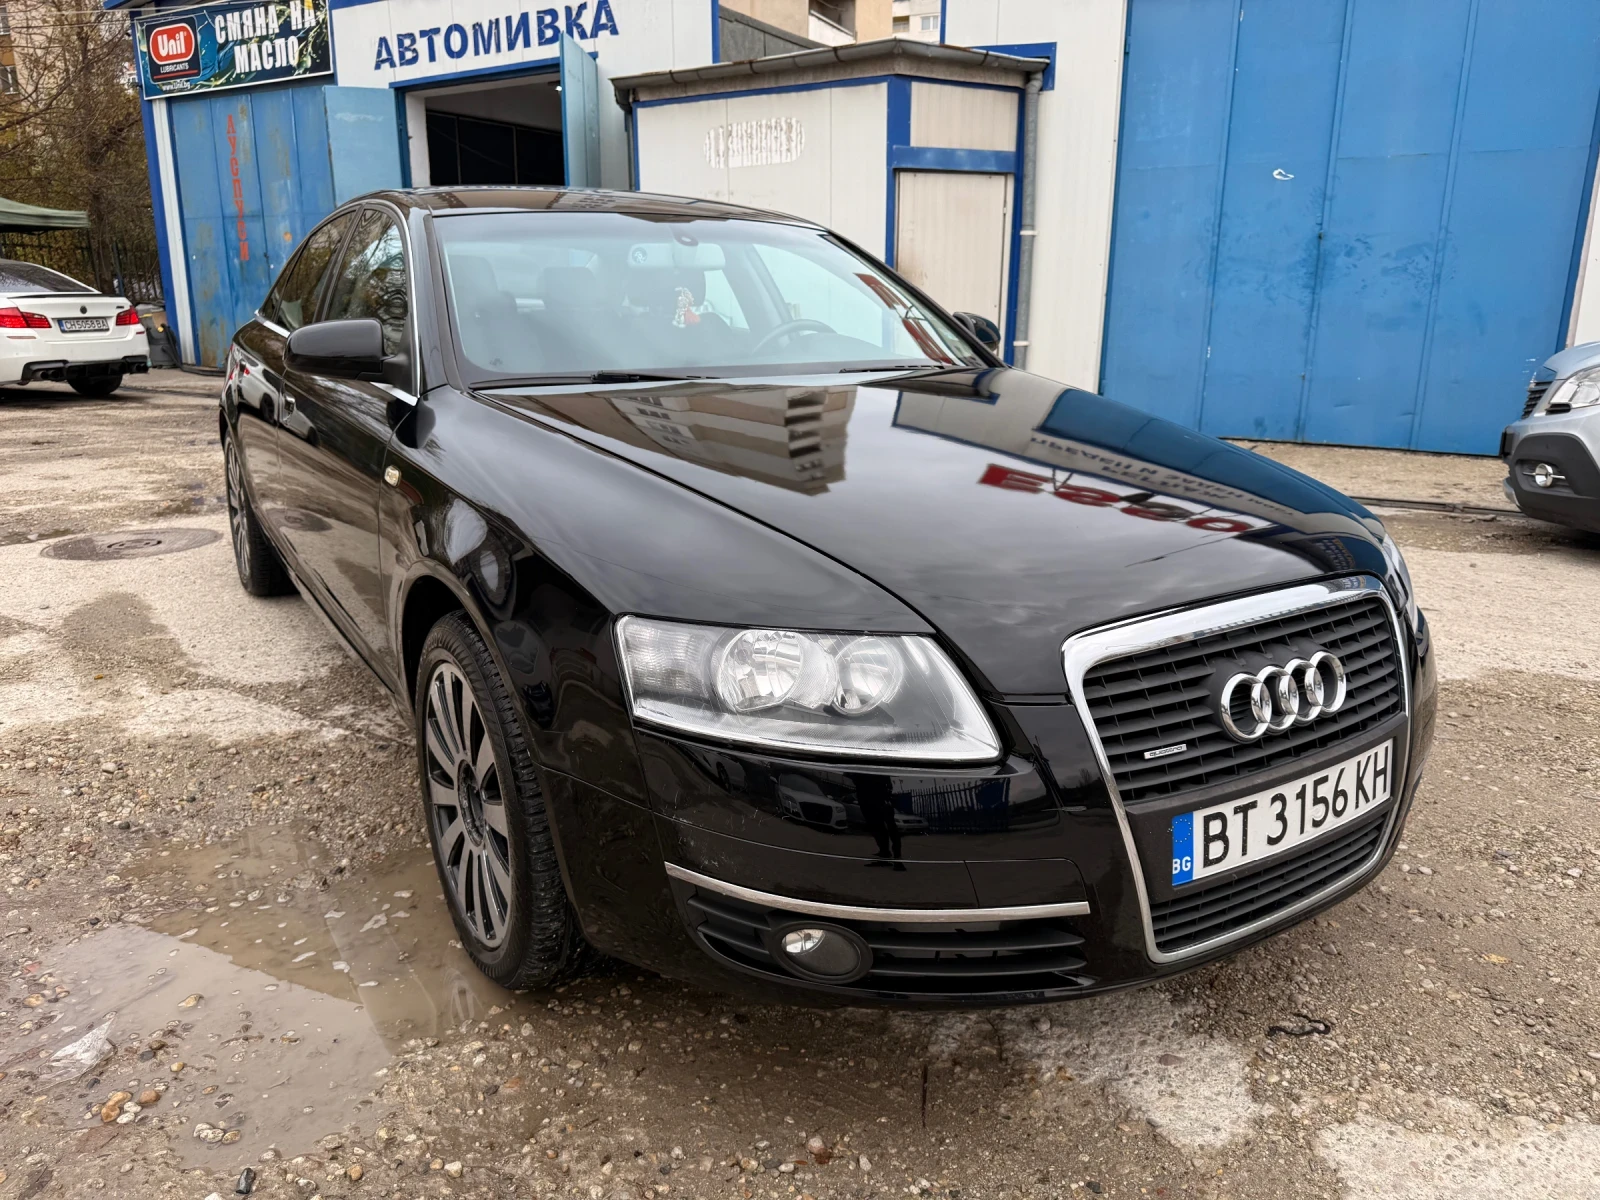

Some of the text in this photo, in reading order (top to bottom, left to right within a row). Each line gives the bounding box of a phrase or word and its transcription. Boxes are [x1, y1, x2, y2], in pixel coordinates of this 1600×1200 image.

[214, 0, 316, 44] СМЯНА НА
[374, 0, 619, 71] АВТОМИВКА
[160, 62, 189, 73] LUBRICANTS
[234, 36, 299, 74] МАСЛО
[226, 114, 249, 261] АУСПУСИ
[1172, 856, 1191, 874] BG
